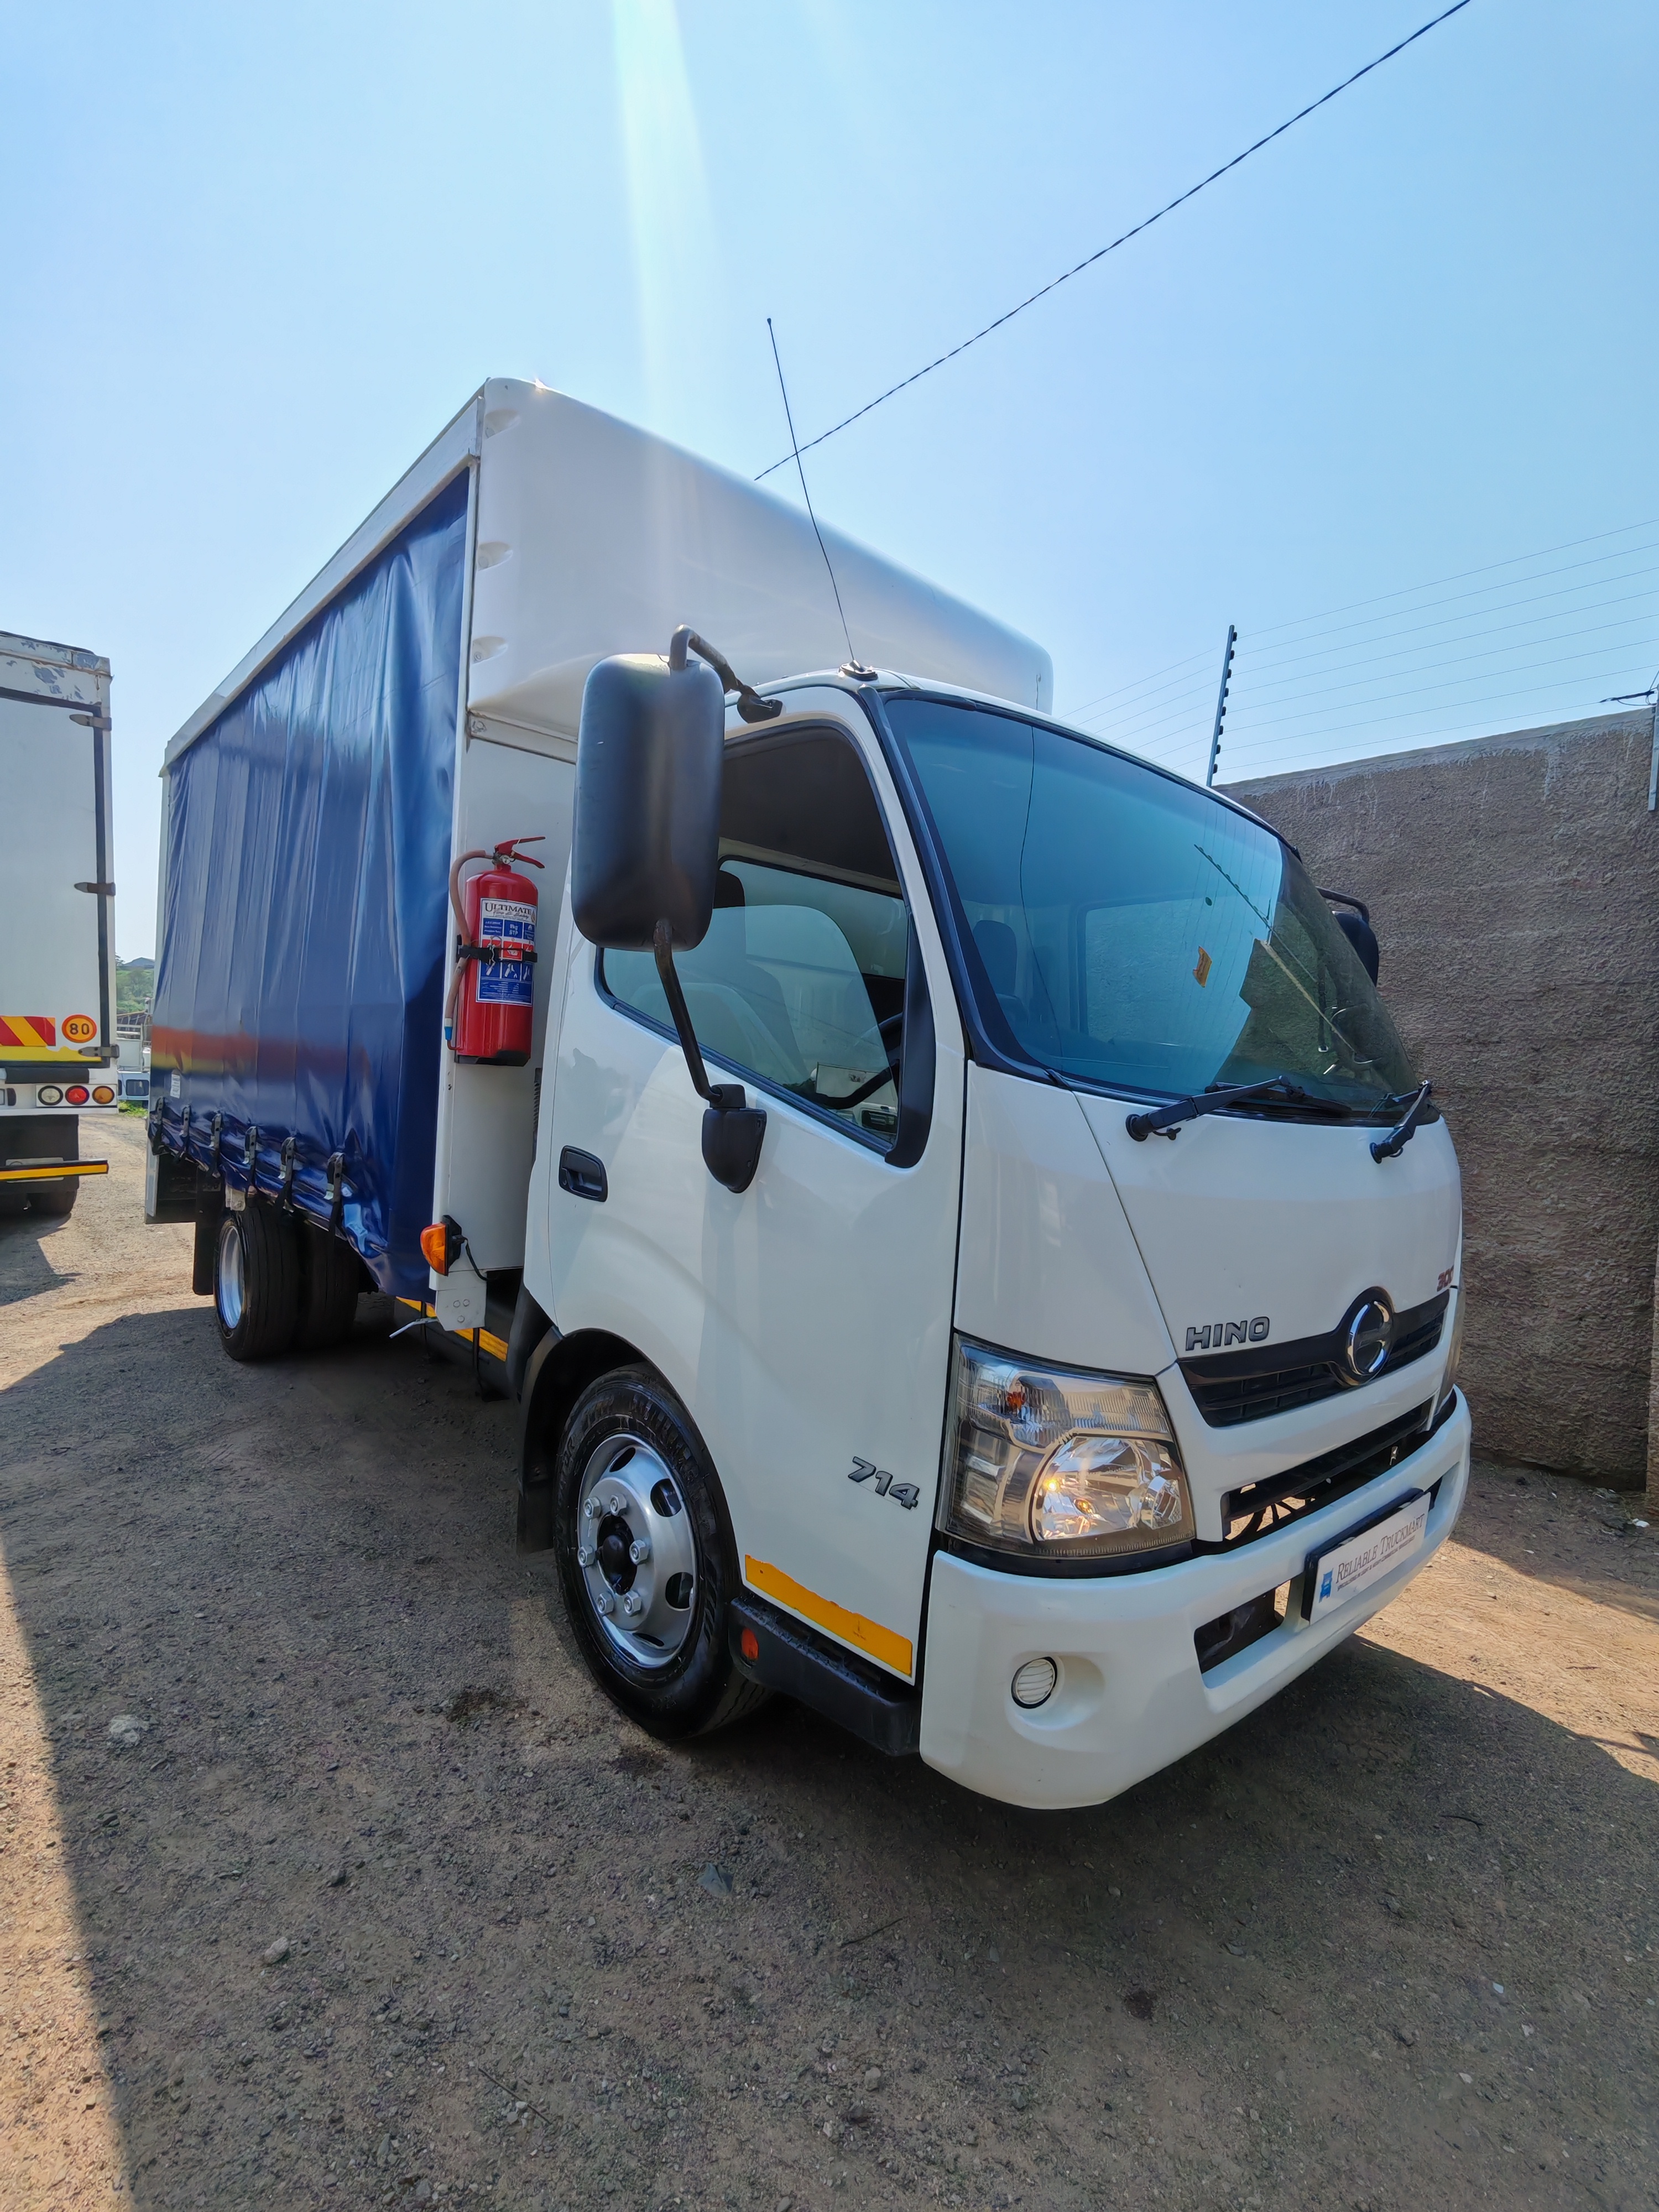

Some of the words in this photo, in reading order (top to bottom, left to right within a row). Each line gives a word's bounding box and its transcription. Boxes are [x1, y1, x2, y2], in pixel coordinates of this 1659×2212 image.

[484, 902, 531, 915] ULTIMATE
[70, 1023, 90, 1035] 80
[1185, 1316, 1270, 1351] HINO
[848, 1456, 920, 1510] 714
[1335, 1545, 1379, 1584] RELIABLE
